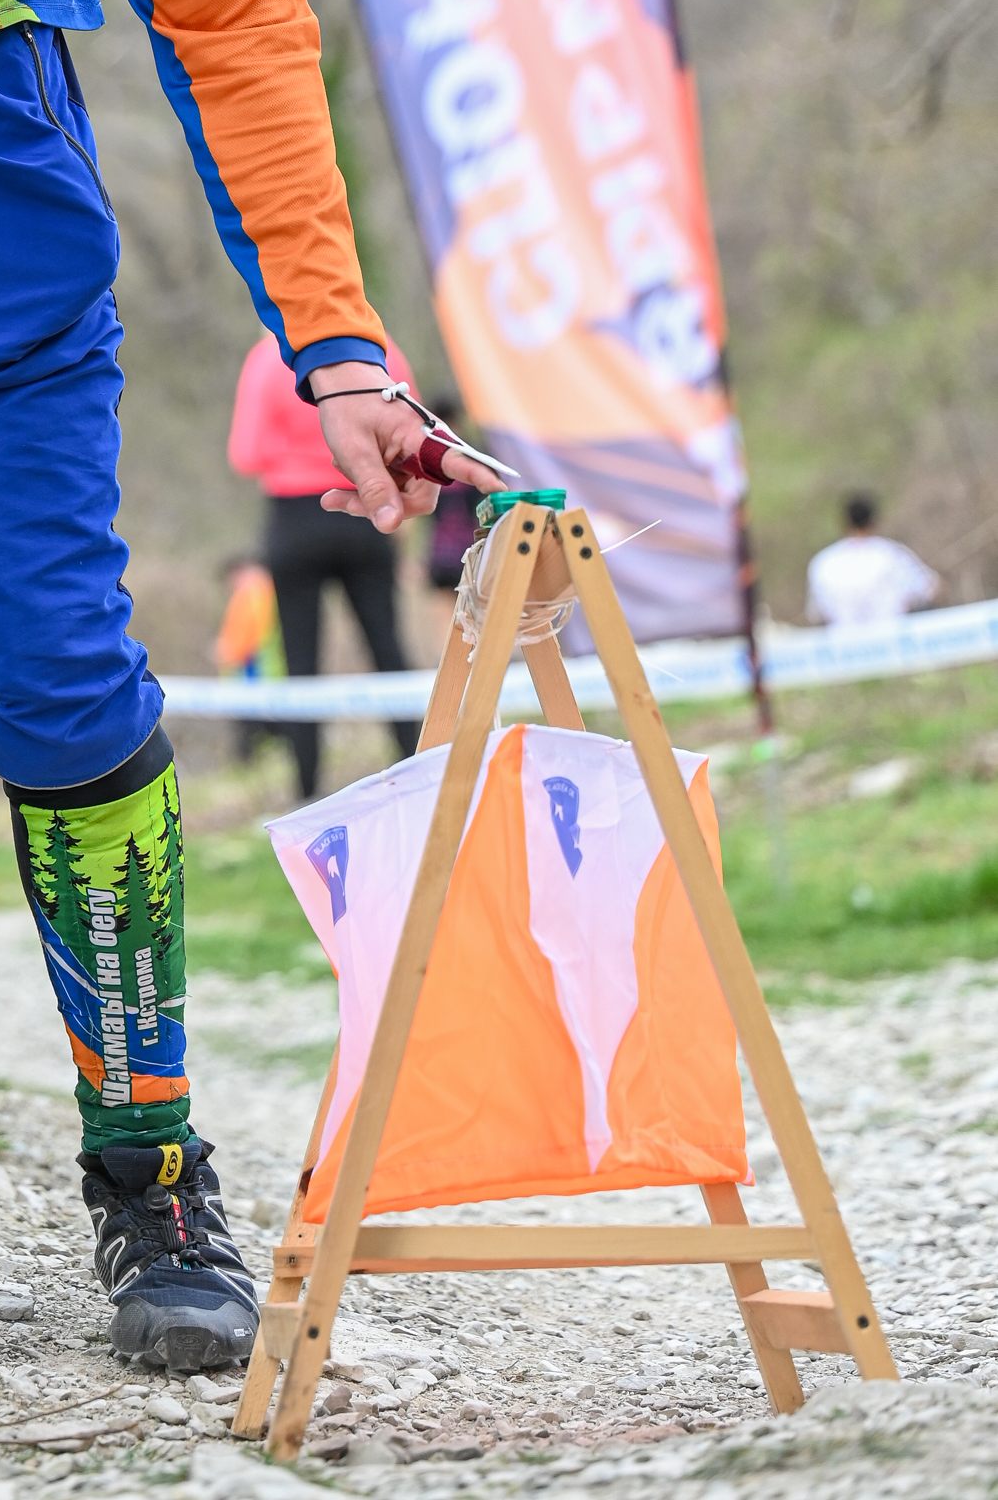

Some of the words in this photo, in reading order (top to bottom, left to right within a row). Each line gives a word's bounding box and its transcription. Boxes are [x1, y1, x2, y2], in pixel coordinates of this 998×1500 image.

[86, 888, 118, 947] бегу
[95, 952, 122, 986] на
[99, 990, 131, 1108] Шахмаы
[142, 1031, 159, 1047] г.
